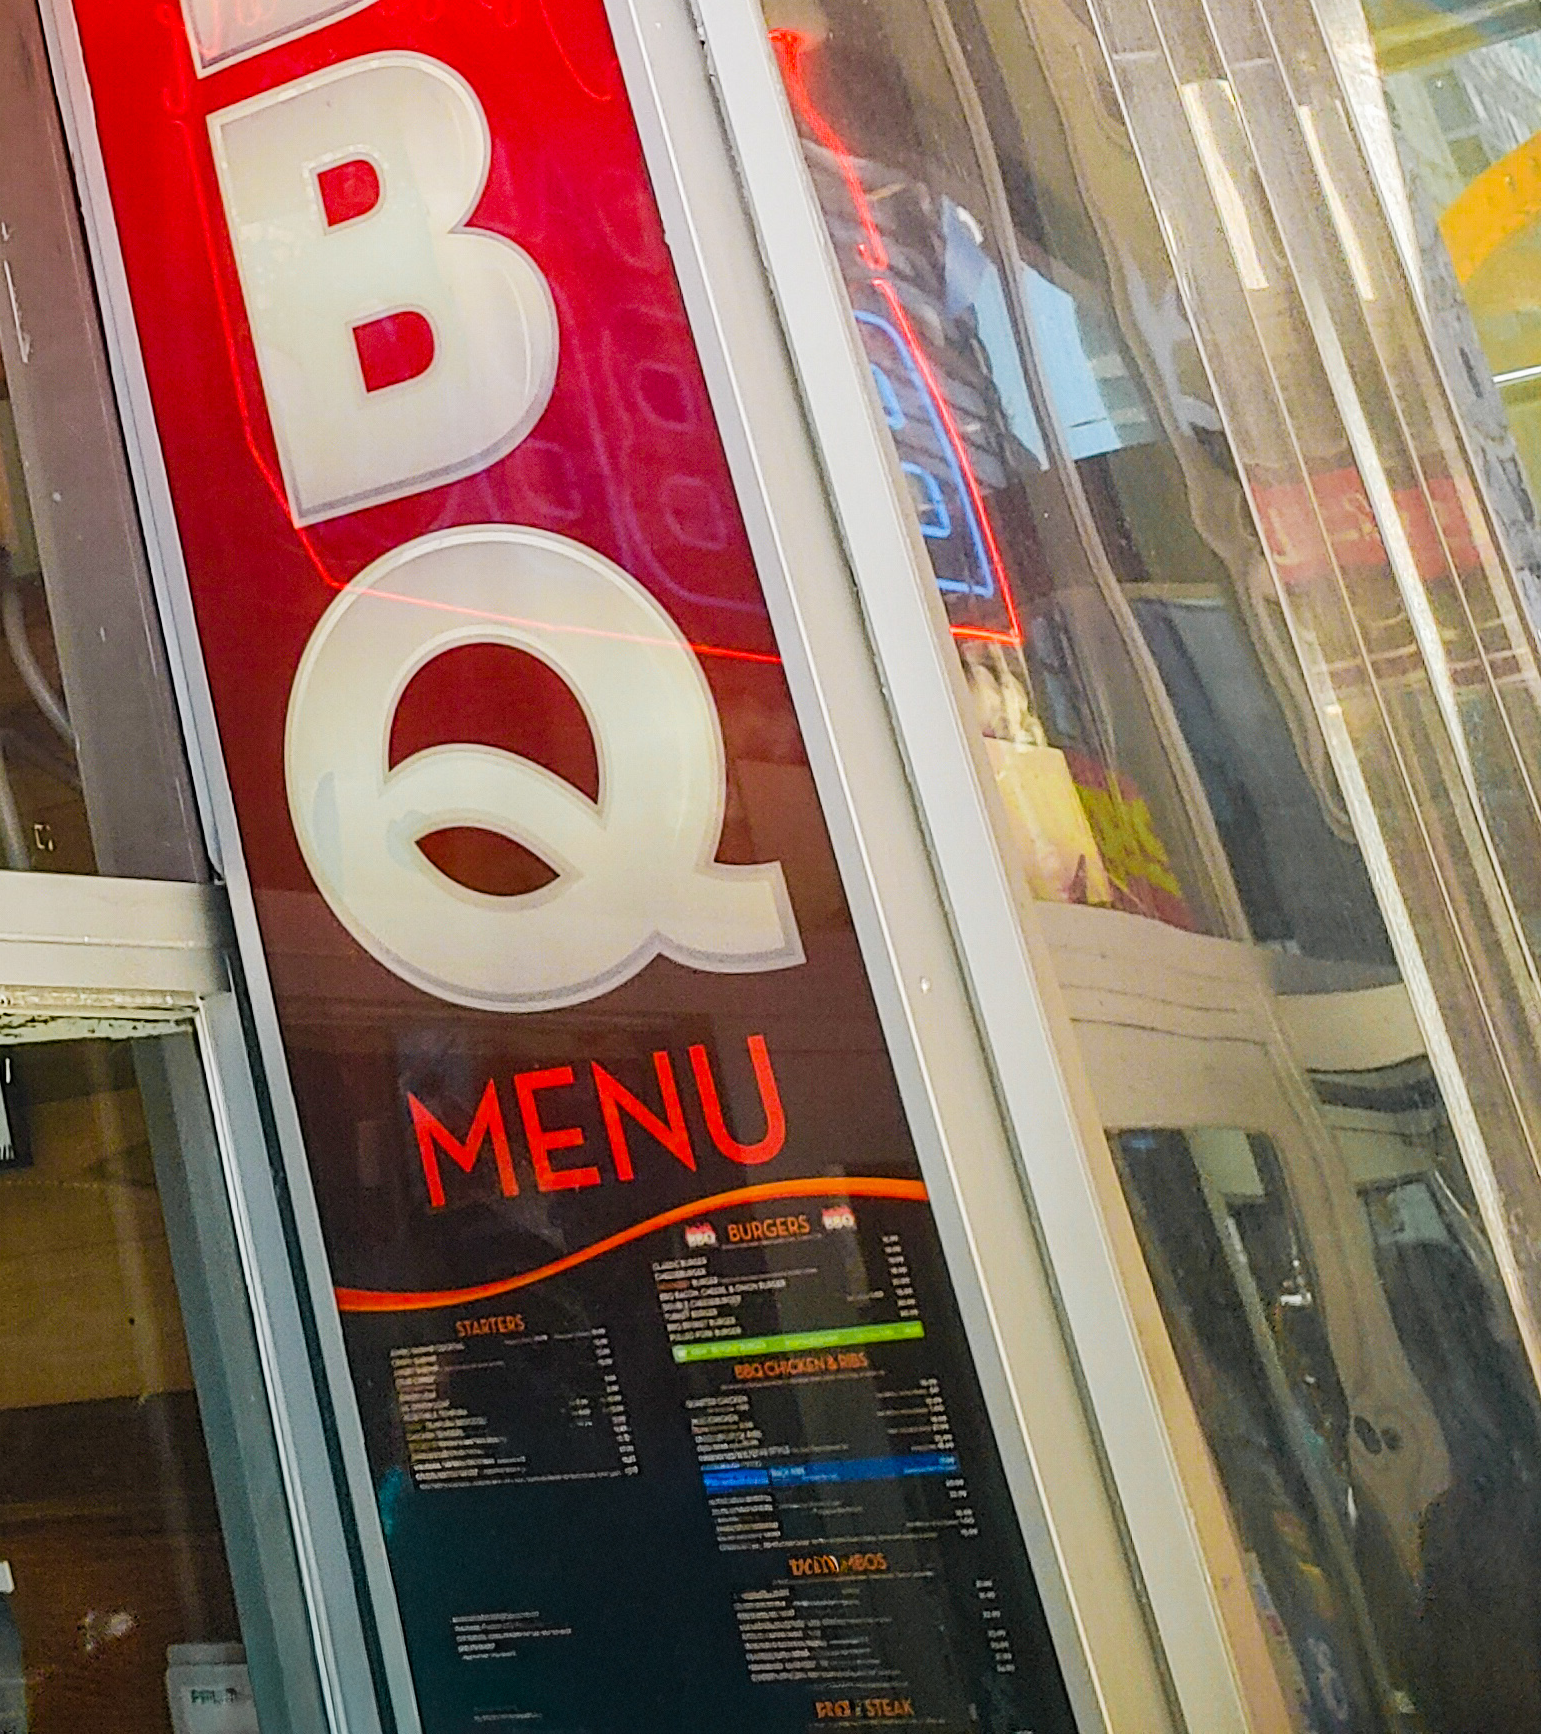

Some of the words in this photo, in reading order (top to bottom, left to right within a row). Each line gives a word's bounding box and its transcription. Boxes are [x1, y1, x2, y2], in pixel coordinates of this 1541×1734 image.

[407, 1034, 786, 1207] MENU
[727, 1214, 810, 1243] BURGERS
[455, 1313, 526, 1338] STARTERS
[733, 1364, 763, 1380] BBQ
[764, 1357, 825, 1378] CHICKEN
[838, 1351, 869, 1368] RIBS
